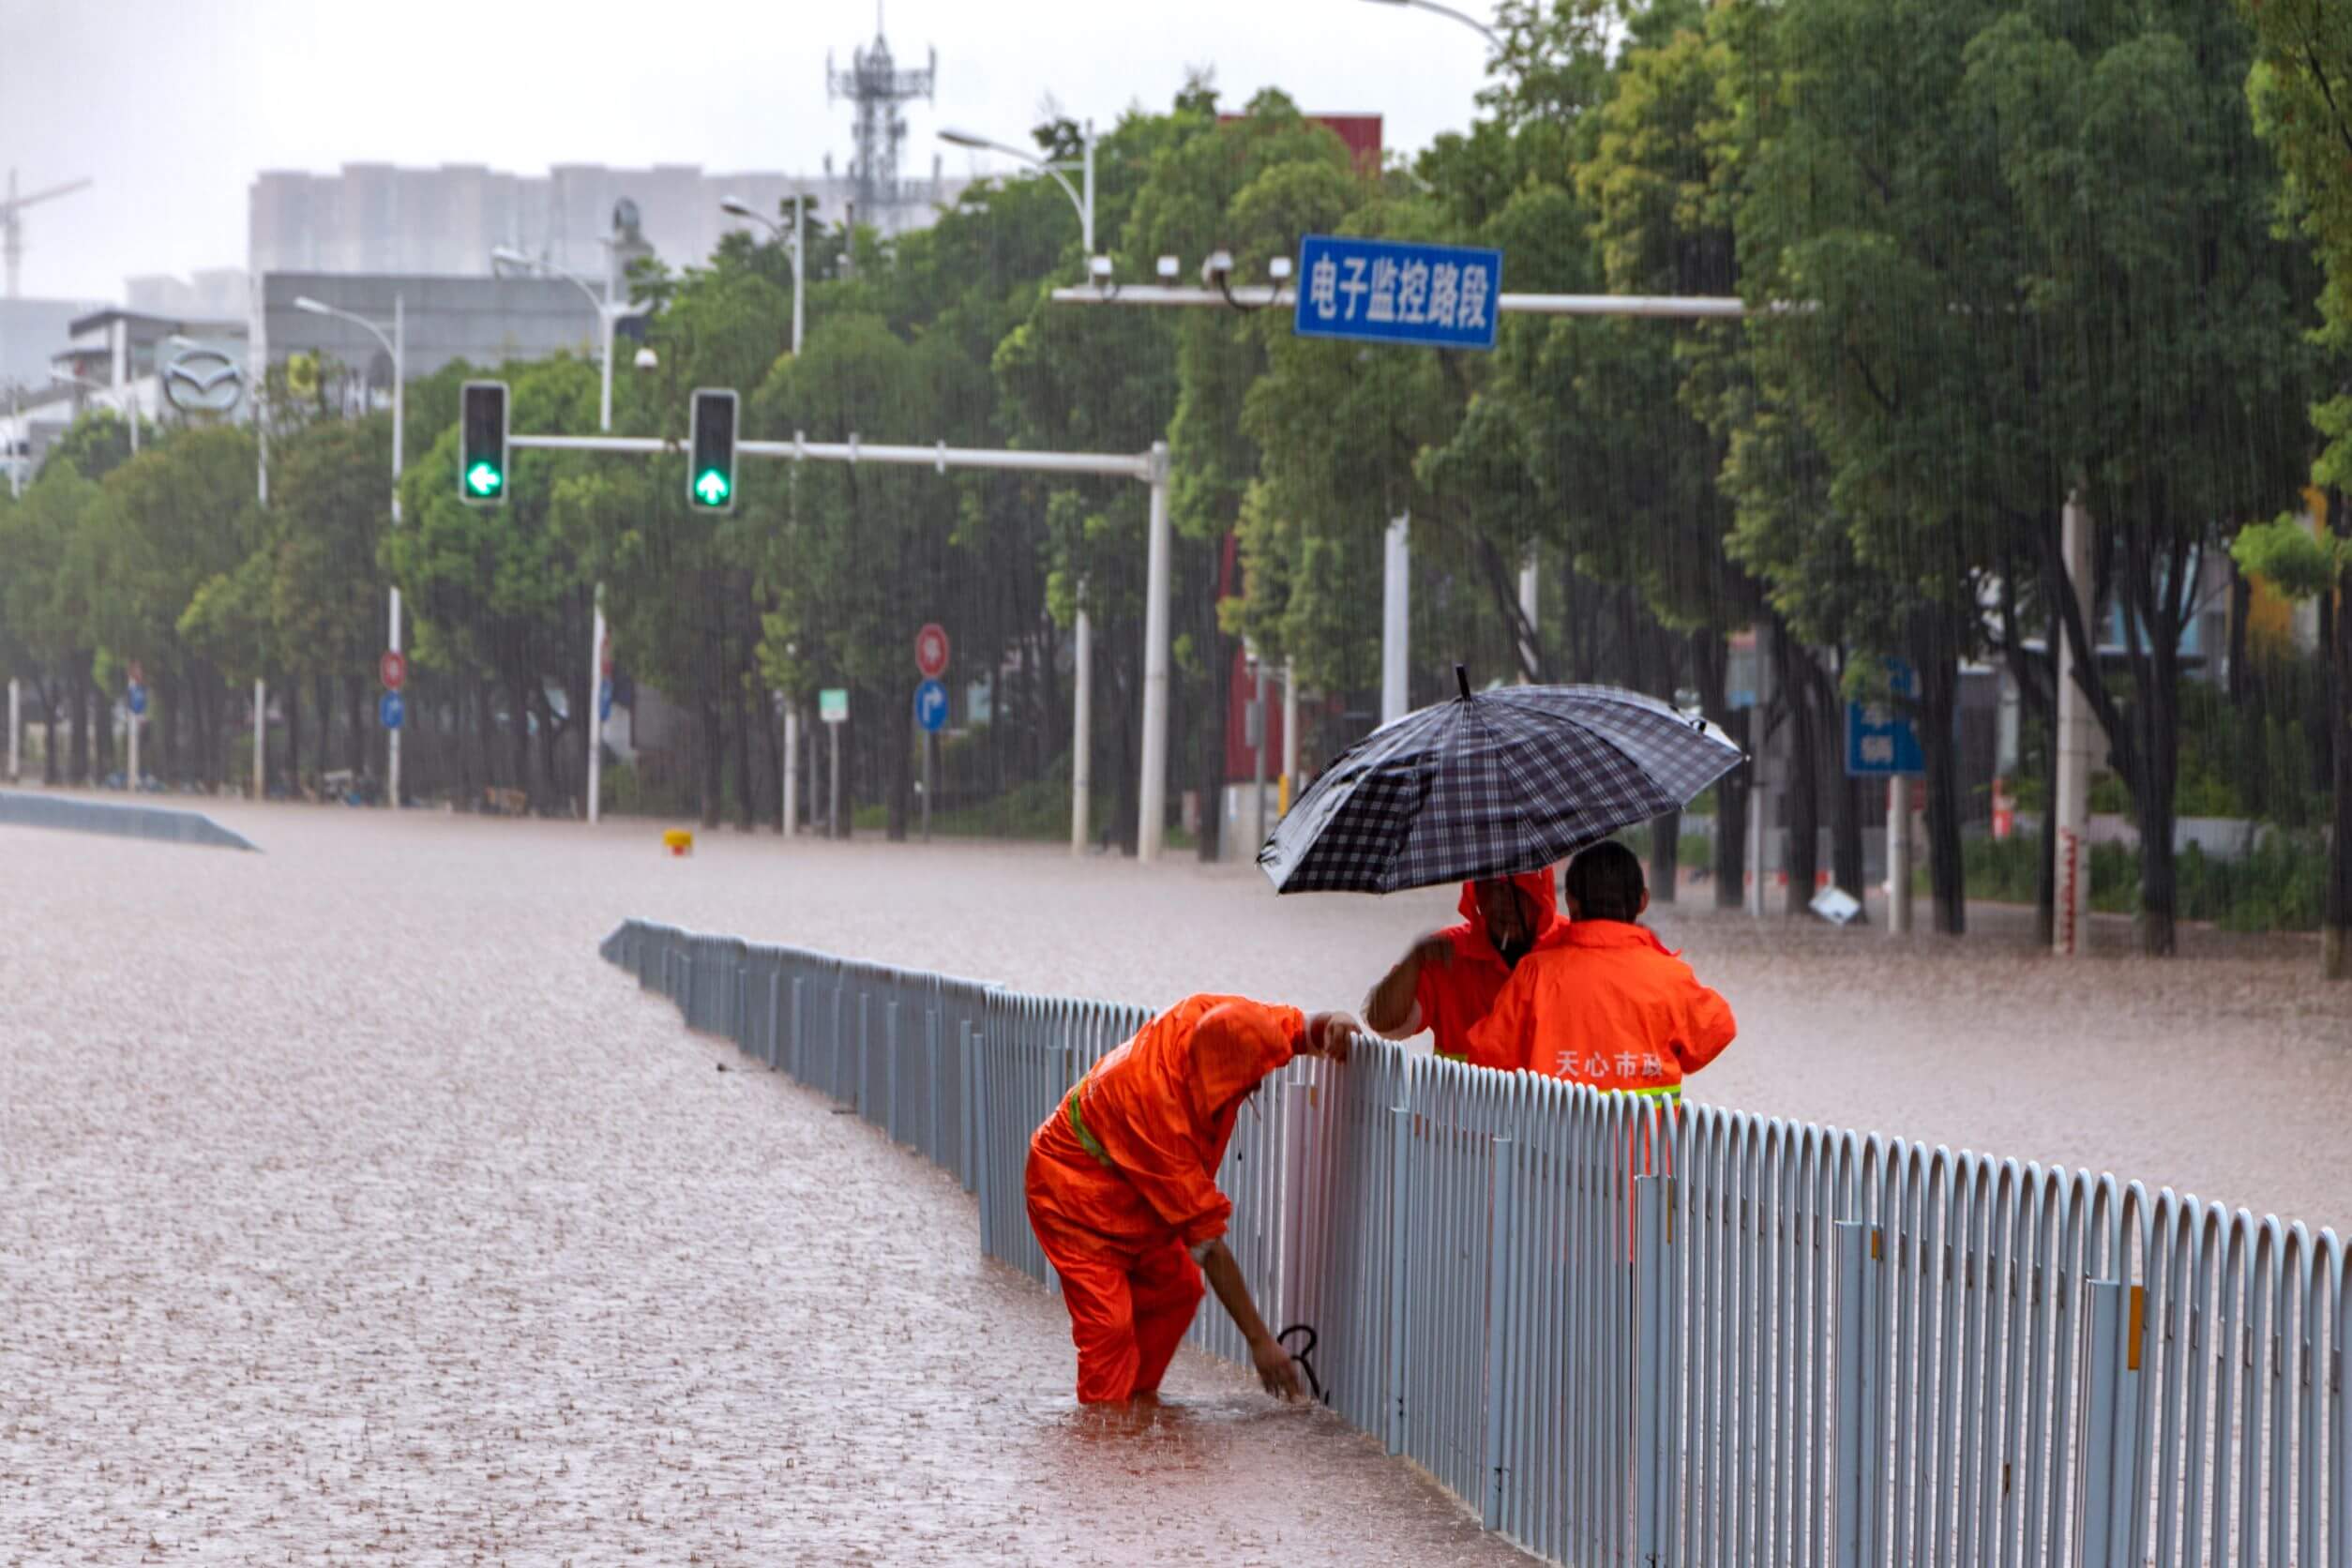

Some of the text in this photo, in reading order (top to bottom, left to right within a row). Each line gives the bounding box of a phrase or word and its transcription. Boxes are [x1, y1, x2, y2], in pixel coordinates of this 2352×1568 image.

[1310, 251, 1489, 329] 电子监控路段
[1555, 1049, 1663, 1079] 天心市政
